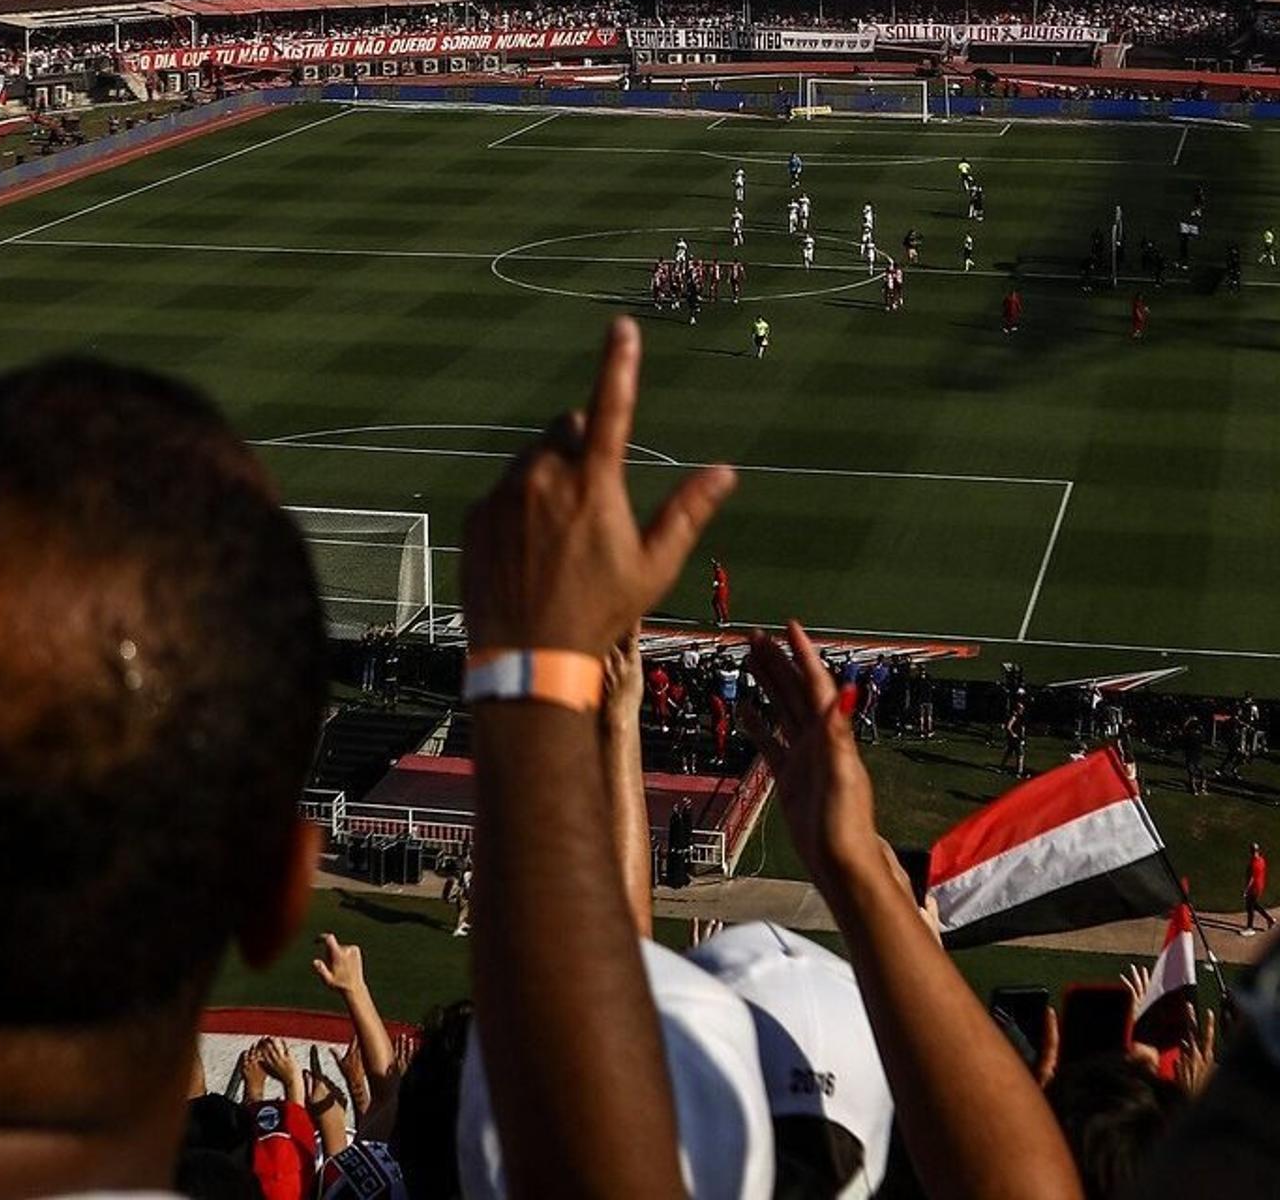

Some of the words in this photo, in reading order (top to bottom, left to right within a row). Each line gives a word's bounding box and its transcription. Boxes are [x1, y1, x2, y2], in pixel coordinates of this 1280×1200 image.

[153, 52, 176, 69] DIA
[215, 49, 234, 65] TU
[330, 40, 350, 57] EU
[353, 36, 386, 55] NÃO
[388, 36, 436, 54] QUERO
[439, 34, 491, 51] SORRIR
[495, 32, 544, 49] NUNCA
[549, 30, 591, 47] MAIS!
[630, 29, 679, 48] SEMPRE
